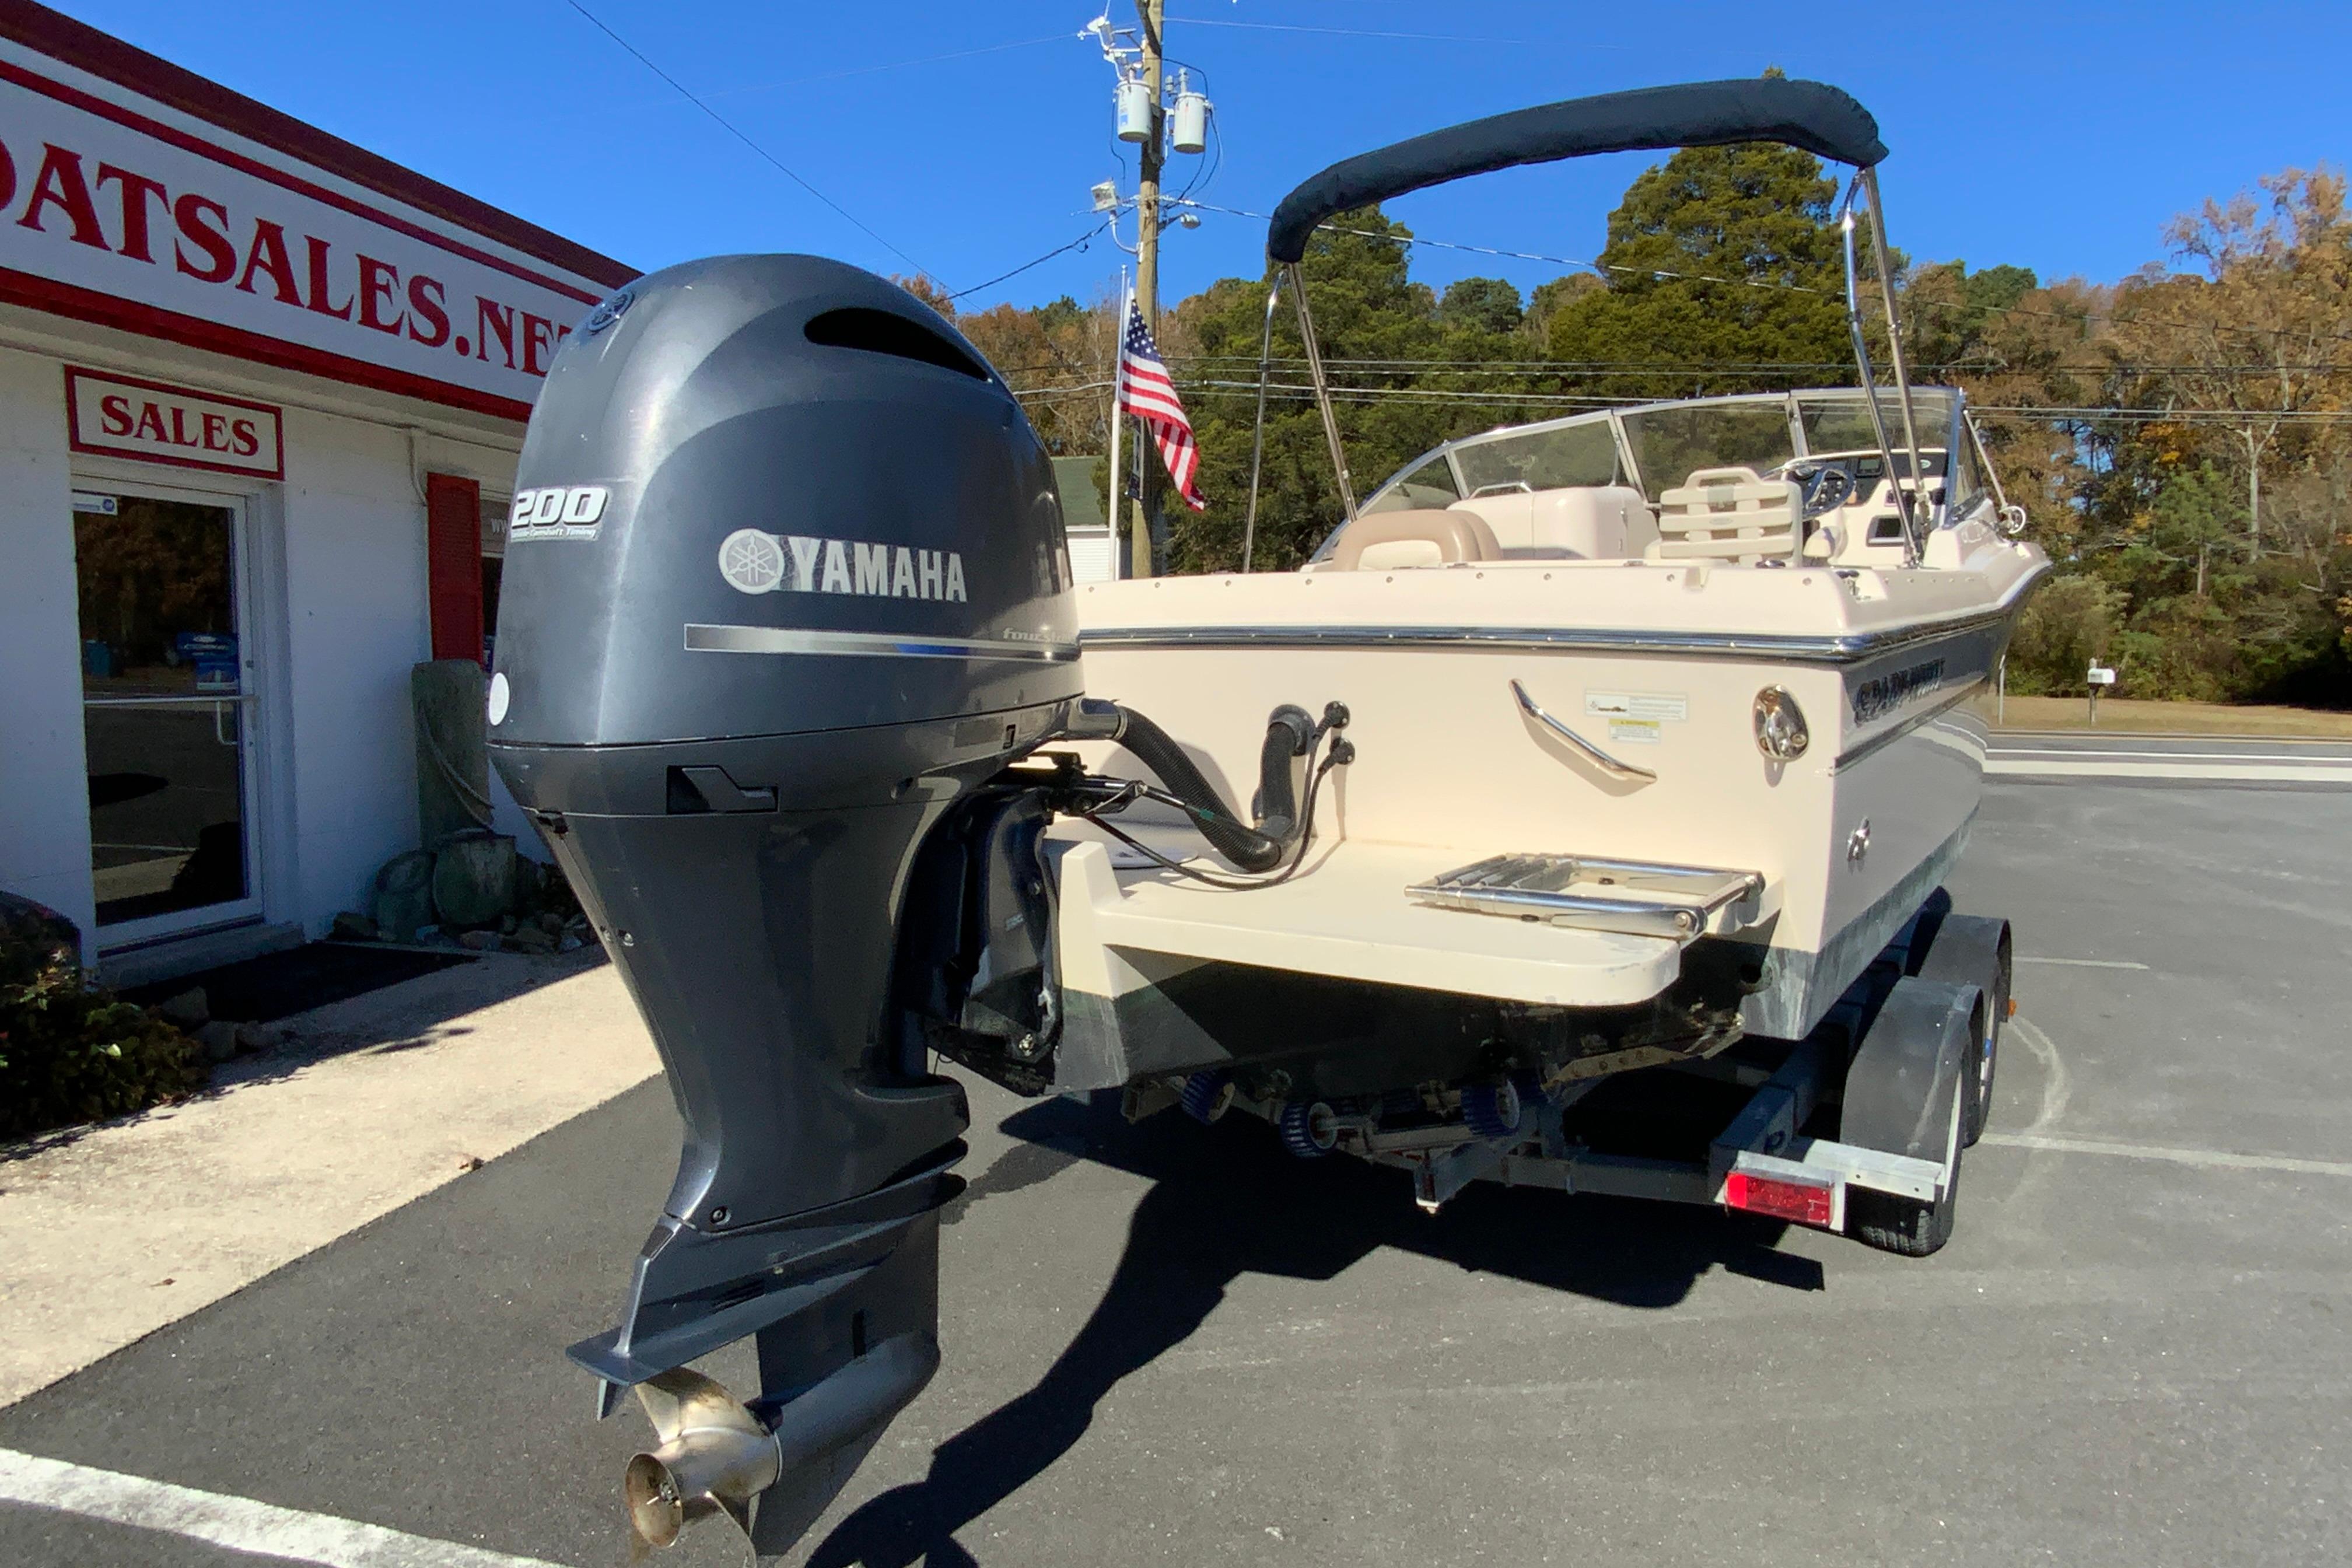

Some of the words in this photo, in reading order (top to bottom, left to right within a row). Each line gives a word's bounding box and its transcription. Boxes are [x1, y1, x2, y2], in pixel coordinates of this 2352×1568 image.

[0, 135, 572, 377] ATSALES.NE
[101, 396, 259, 456] SALES
[512, 487, 608, 529] 200
[788, 536, 968, 603] YAMAHA
